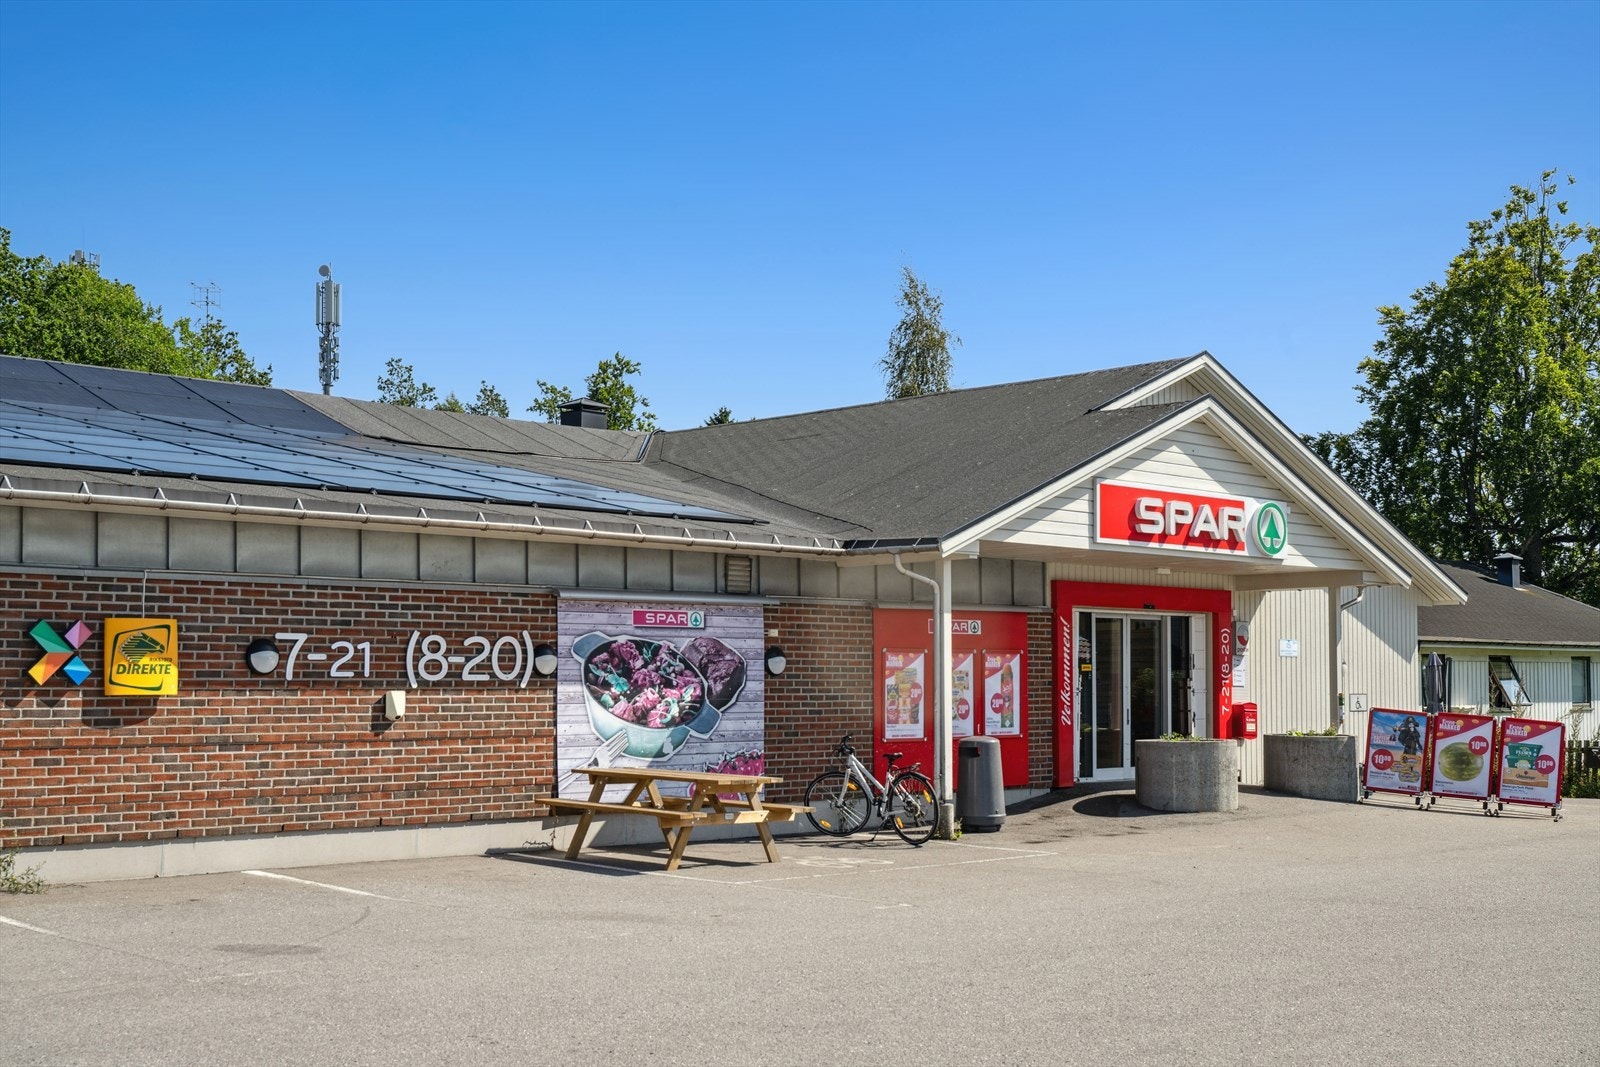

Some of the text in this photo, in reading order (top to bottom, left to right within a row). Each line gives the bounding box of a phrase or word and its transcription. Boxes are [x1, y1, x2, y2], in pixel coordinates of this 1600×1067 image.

[1134, 496, 1246, 543] SPAR
[645, 612, 688, 624] SPAR
[115, 663, 172, 675] DIREKTE
[274, 629, 535, 689] 7-21 (8-20)
[1060, 615, 1072, 726] Velkommen!
